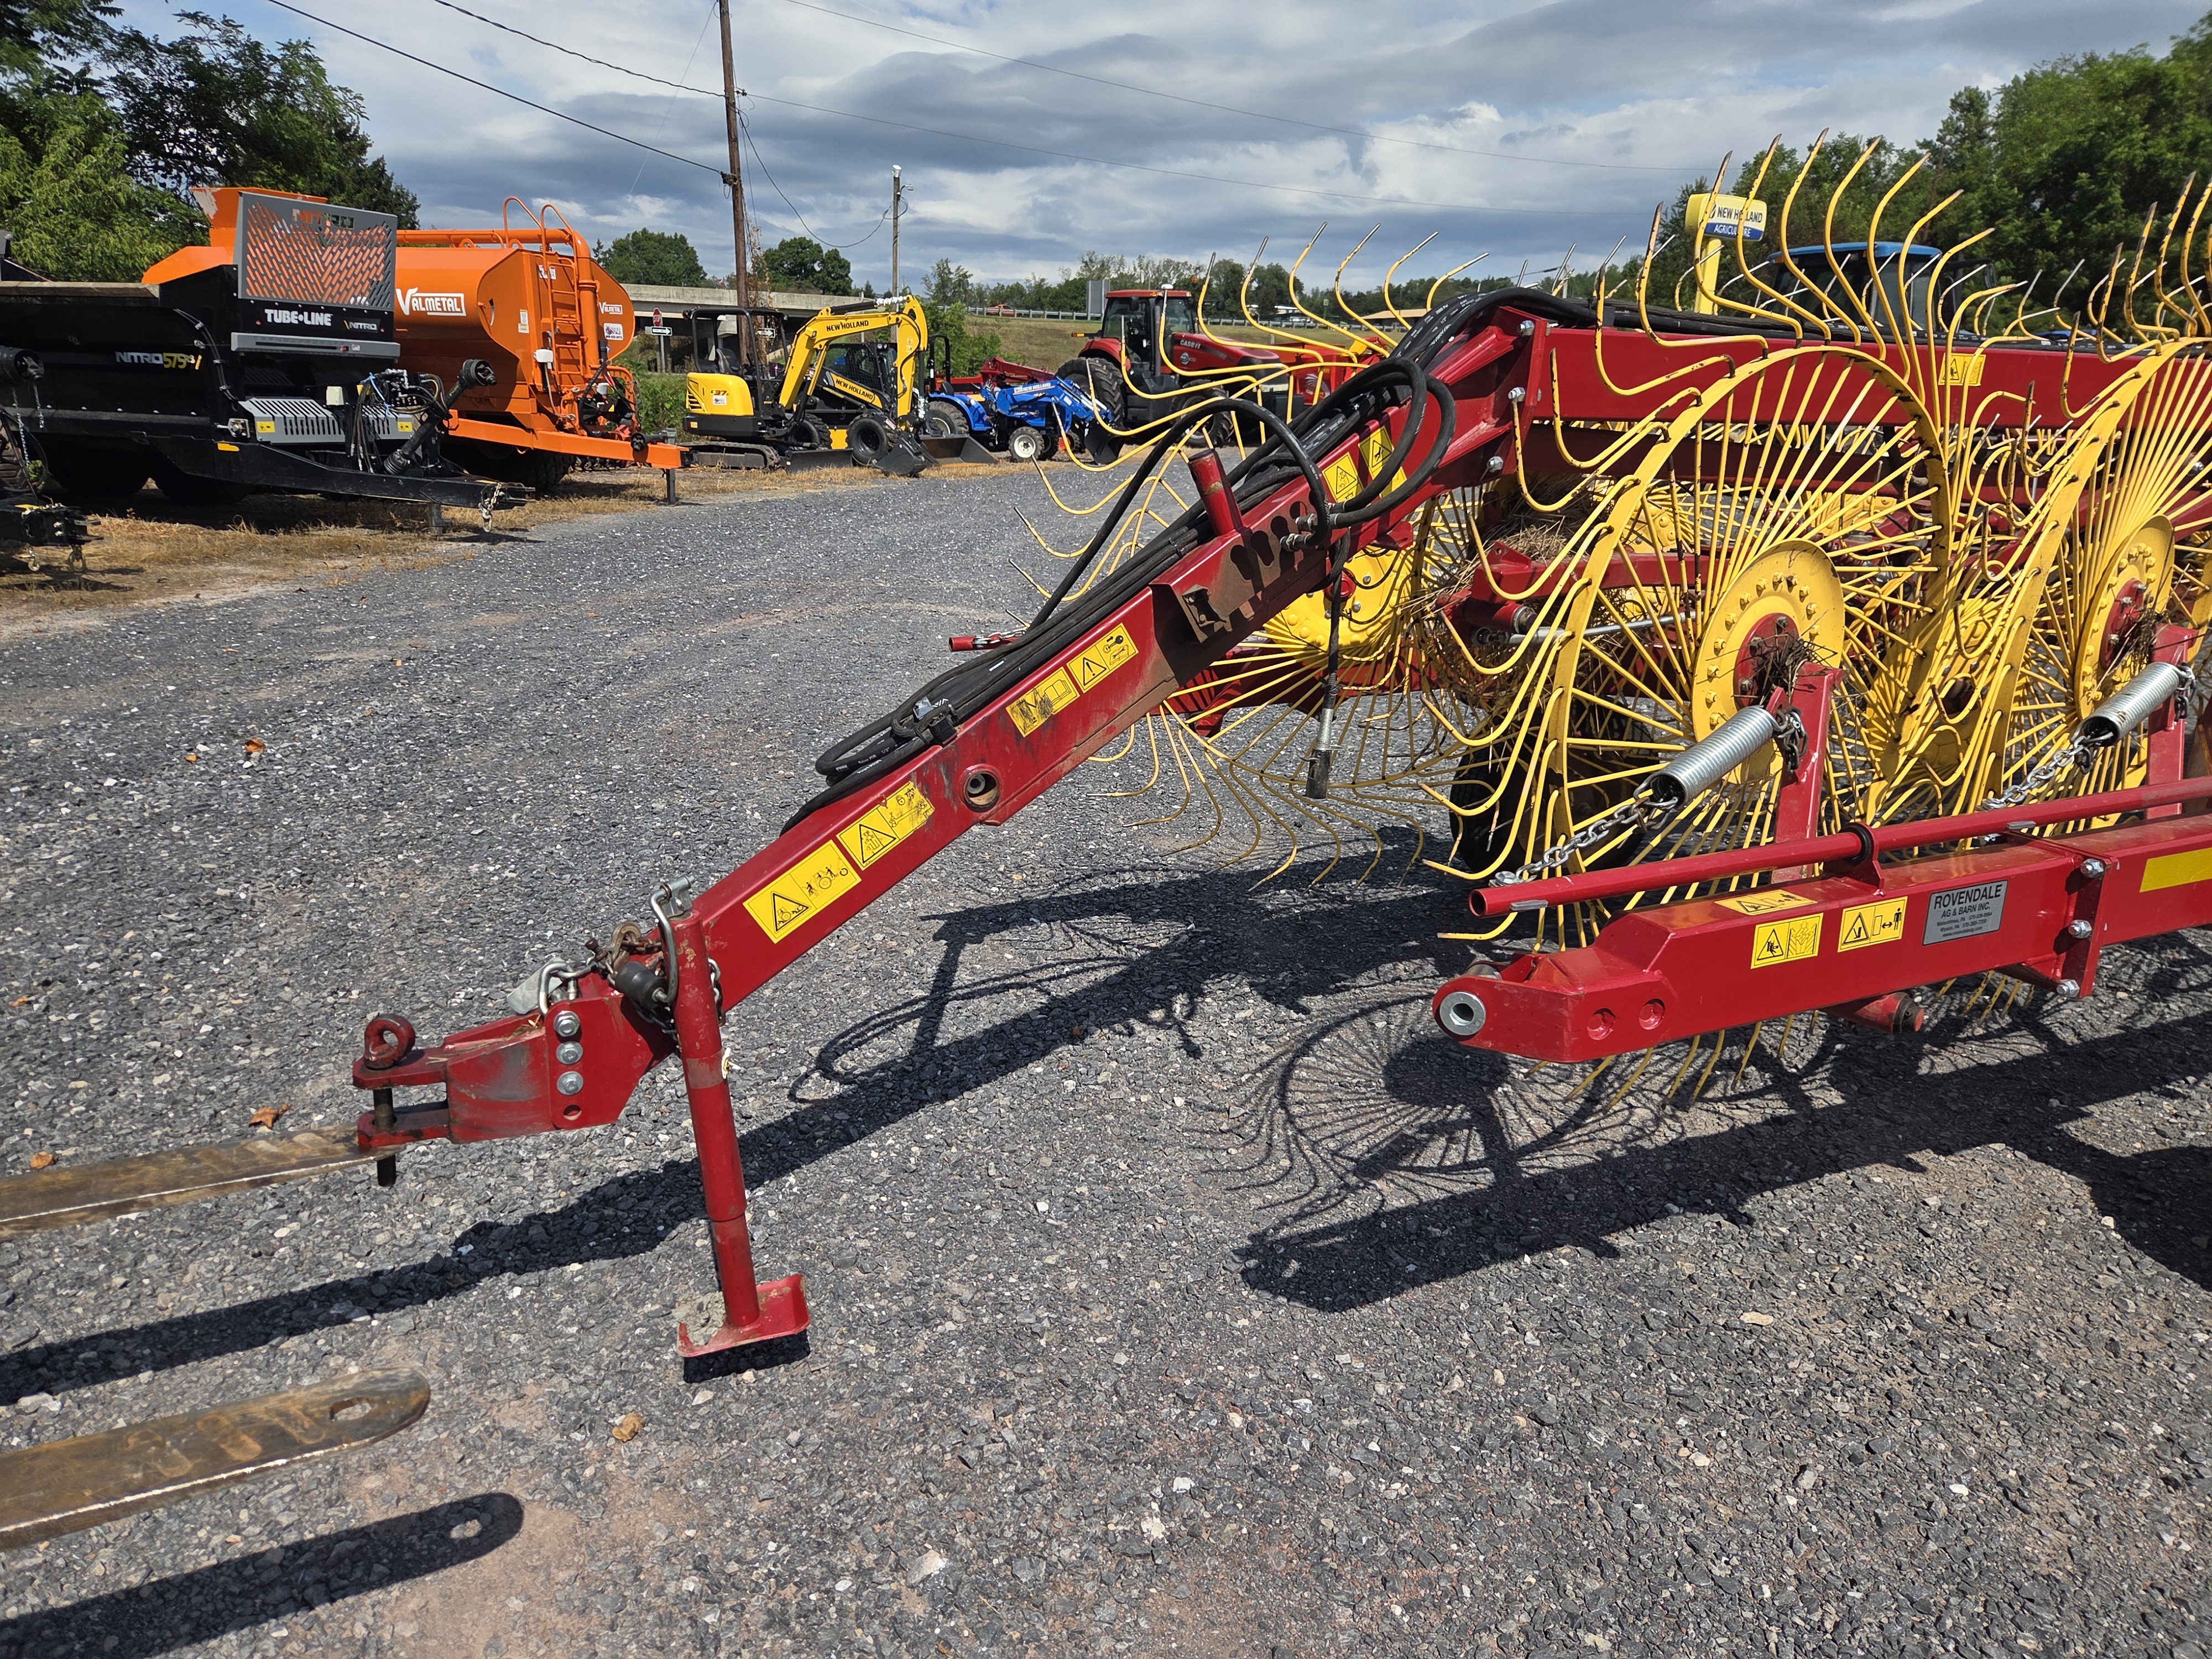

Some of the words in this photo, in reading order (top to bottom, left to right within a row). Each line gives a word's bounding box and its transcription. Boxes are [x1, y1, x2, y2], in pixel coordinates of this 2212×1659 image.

[1717, 206, 1733, 219] NEW
[1734, 209, 1762, 222] HLAND
[395, 287, 461, 315] VALMETAL
[349, 322, 377, 330] NITRO
[841, 320, 869, 330] HOLLAND
[836, 378, 848, 388] NEW
[849, 385, 873, 399] HOLLAND
[1934, 884, 2002, 910] ROVENDALE
[1941, 909, 1951, 919] AG
[1953, 908, 1957, 916] &
[1958, 905, 1977, 915] BARN
[1978, 901, 1991, 911] INC.
